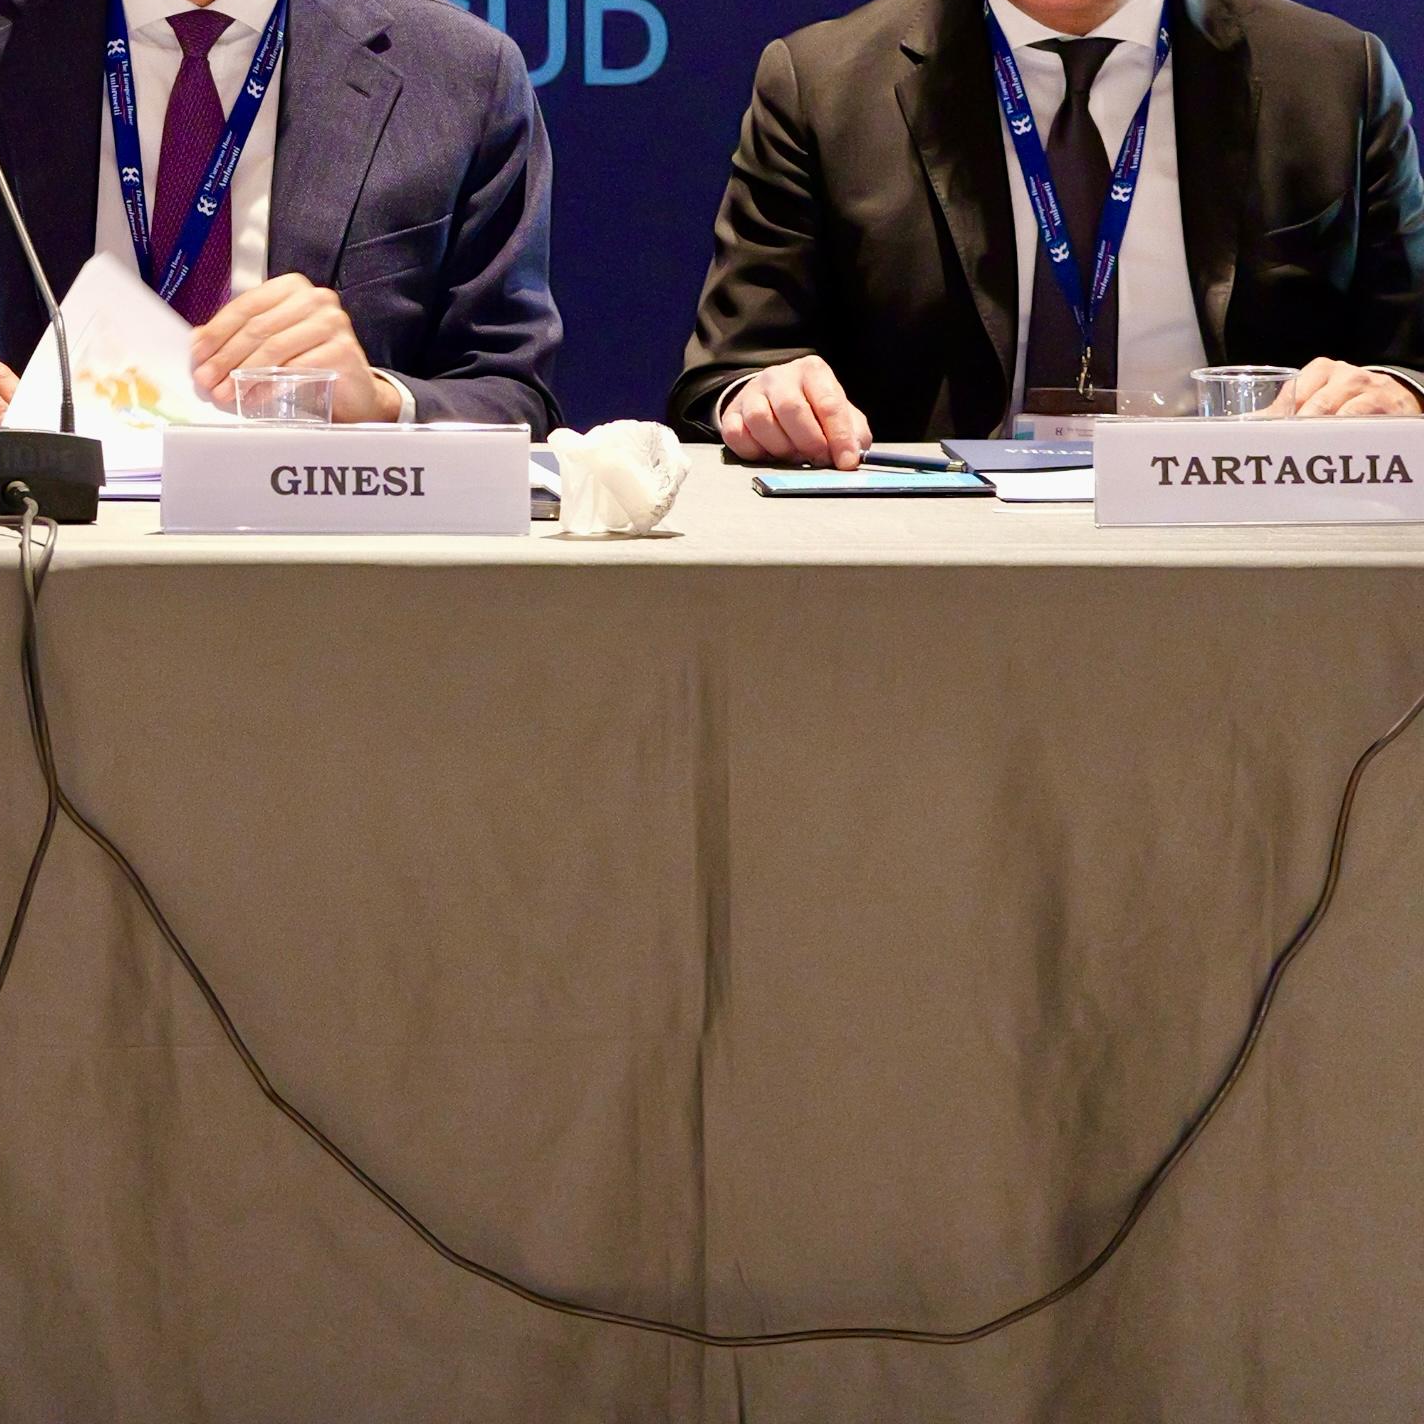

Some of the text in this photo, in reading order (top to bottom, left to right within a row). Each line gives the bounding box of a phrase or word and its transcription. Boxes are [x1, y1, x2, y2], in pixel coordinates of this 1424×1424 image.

[164, 265, 189, 303] mbrosetti
[270, 465, 425, 497] GINESI
[1150, 454, 1414, 486] TARTAGLIA
